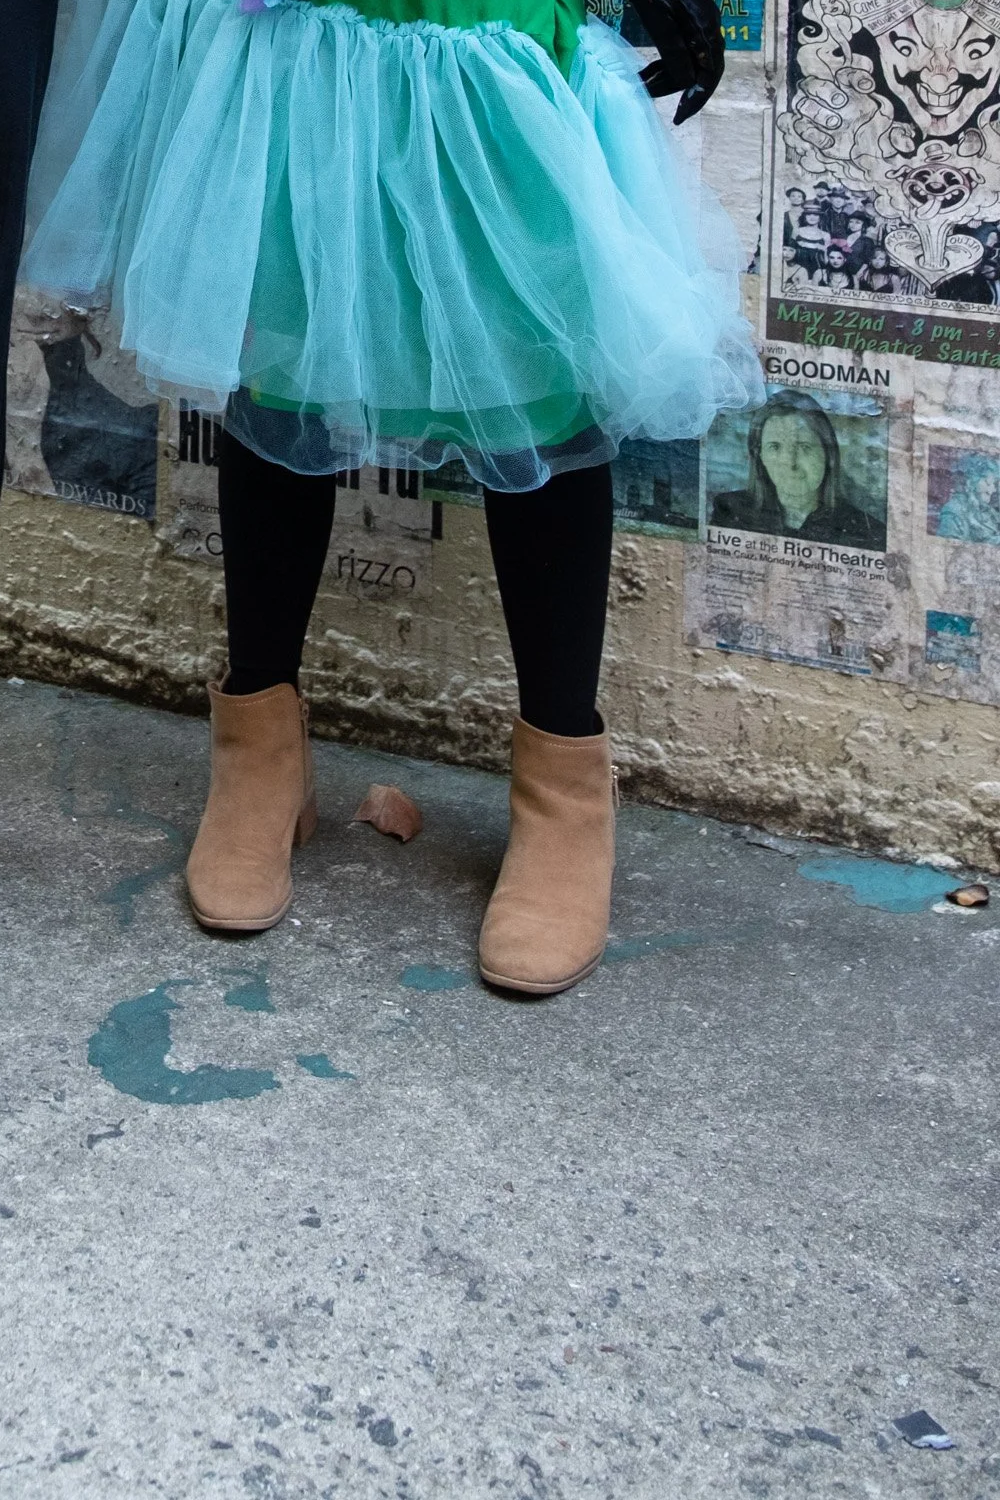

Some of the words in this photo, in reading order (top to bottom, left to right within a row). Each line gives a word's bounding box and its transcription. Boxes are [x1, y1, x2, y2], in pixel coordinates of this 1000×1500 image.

[776, 303, 825, 327] May
[830, 310, 886, 331] 22nd
[911, 318, 925, 336] 8
[930, 327, 963, 342] pm
[803, 326, 836, 345] Rio
[842, 332, 923, 358] Theatre
[937, 345, 1000, 367] Santa
[765, 356, 891, 387] GOODMAN
[706, 545, 731, 557] Santa
[759, 554, 795, 568] Monday
[798, 560, 820, 571] April
[847, 569, 867, 579] 7:30
[869, 573, 885, 581] pm
[707, 529, 741, 547] Live
[745, 540, 757, 550] at
[759, 541, 778, 554] the
[783, 541, 812, 558] Rio
[817, 547, 885, 570] Theatre
